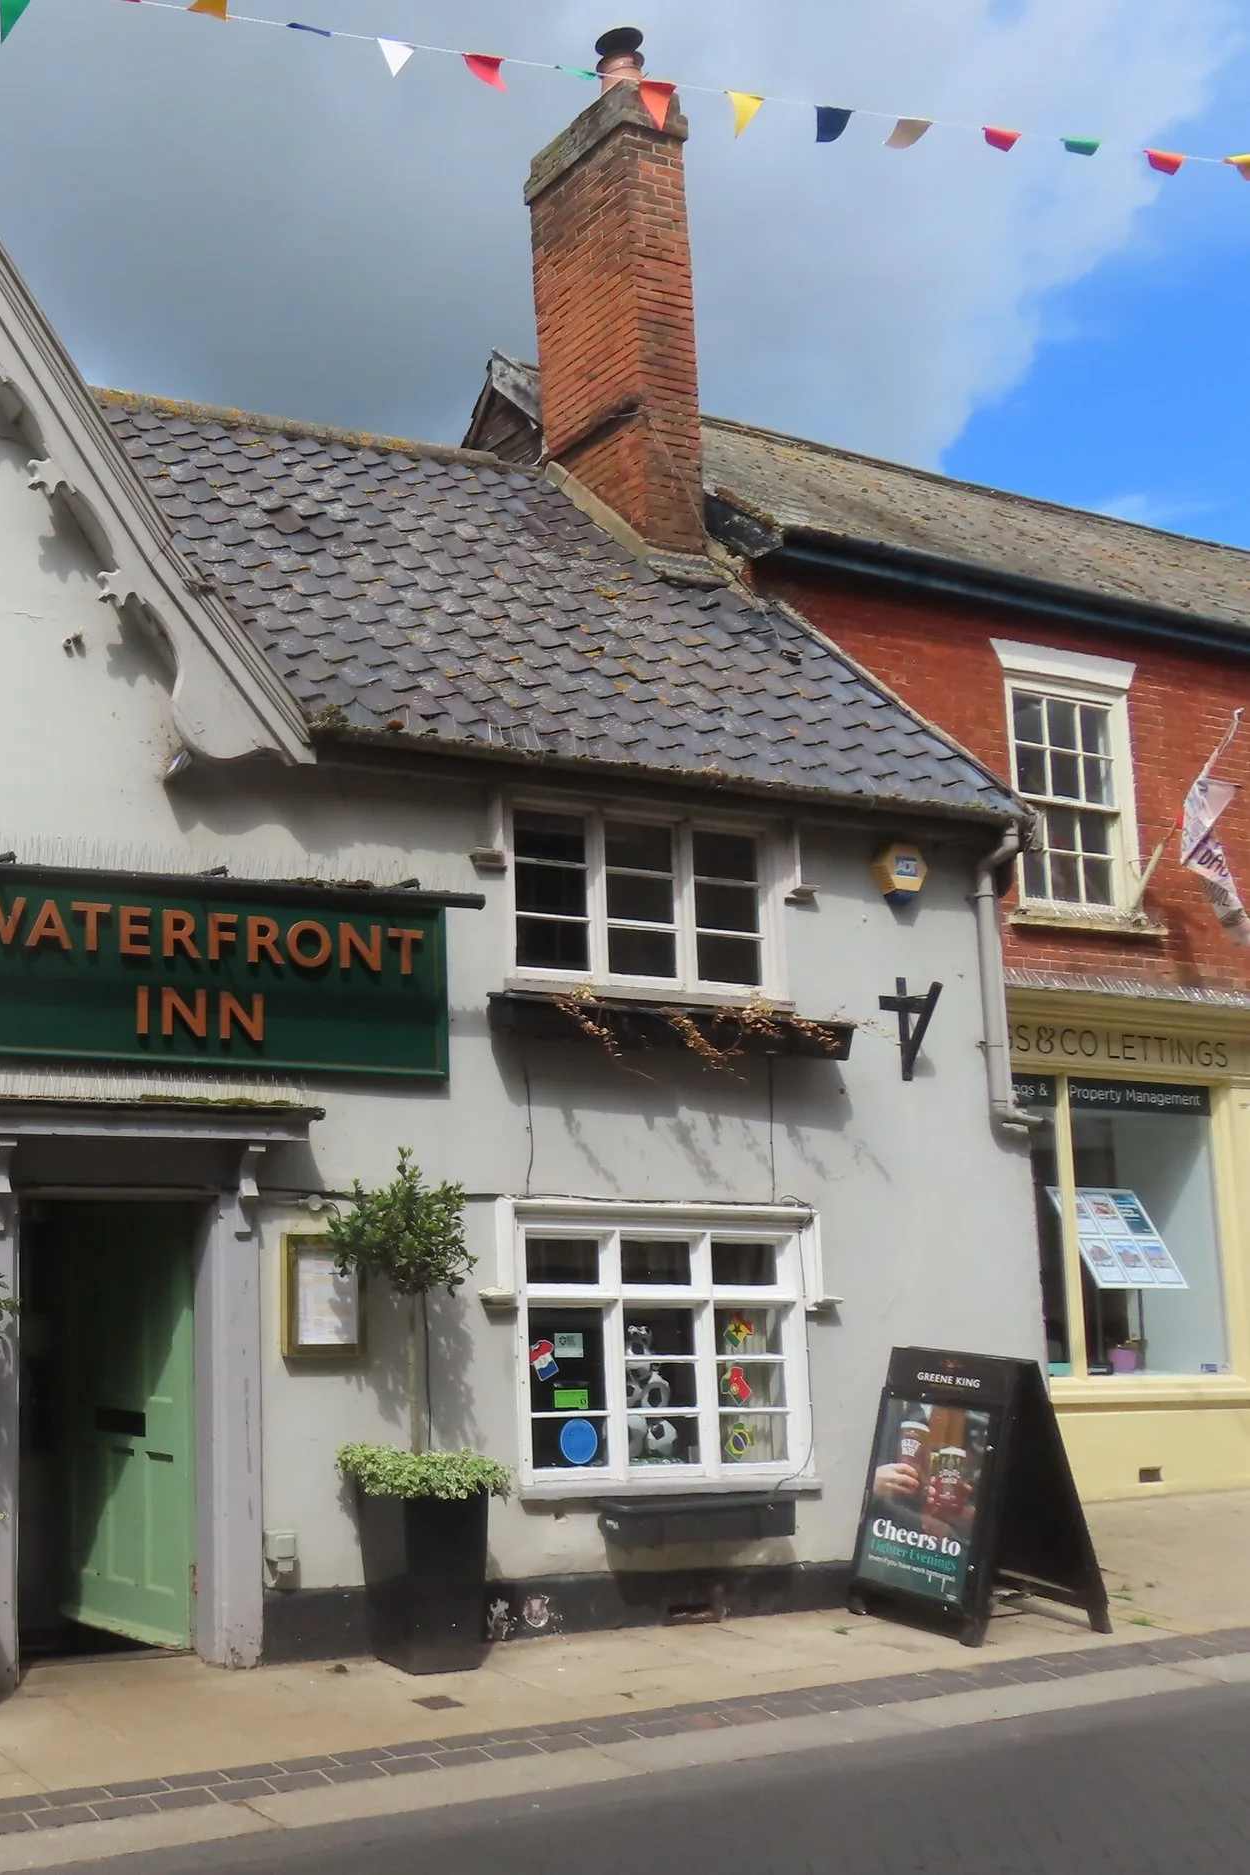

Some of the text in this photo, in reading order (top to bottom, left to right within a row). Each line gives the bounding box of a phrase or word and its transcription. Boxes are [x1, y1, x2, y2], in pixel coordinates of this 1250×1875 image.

[136, 985, 264, 1041] INN
[1106, 1032, 1228, 1068] LETTINGS
[1069, 1085, 1121, 1103] Property
[1125, 1089, 1201, 1106] Management
[917, 1372, 954, 1385] GREENE
[955, 1377, 981, 1388] KING
[872, 1518, 961, 1556] Cheers to
